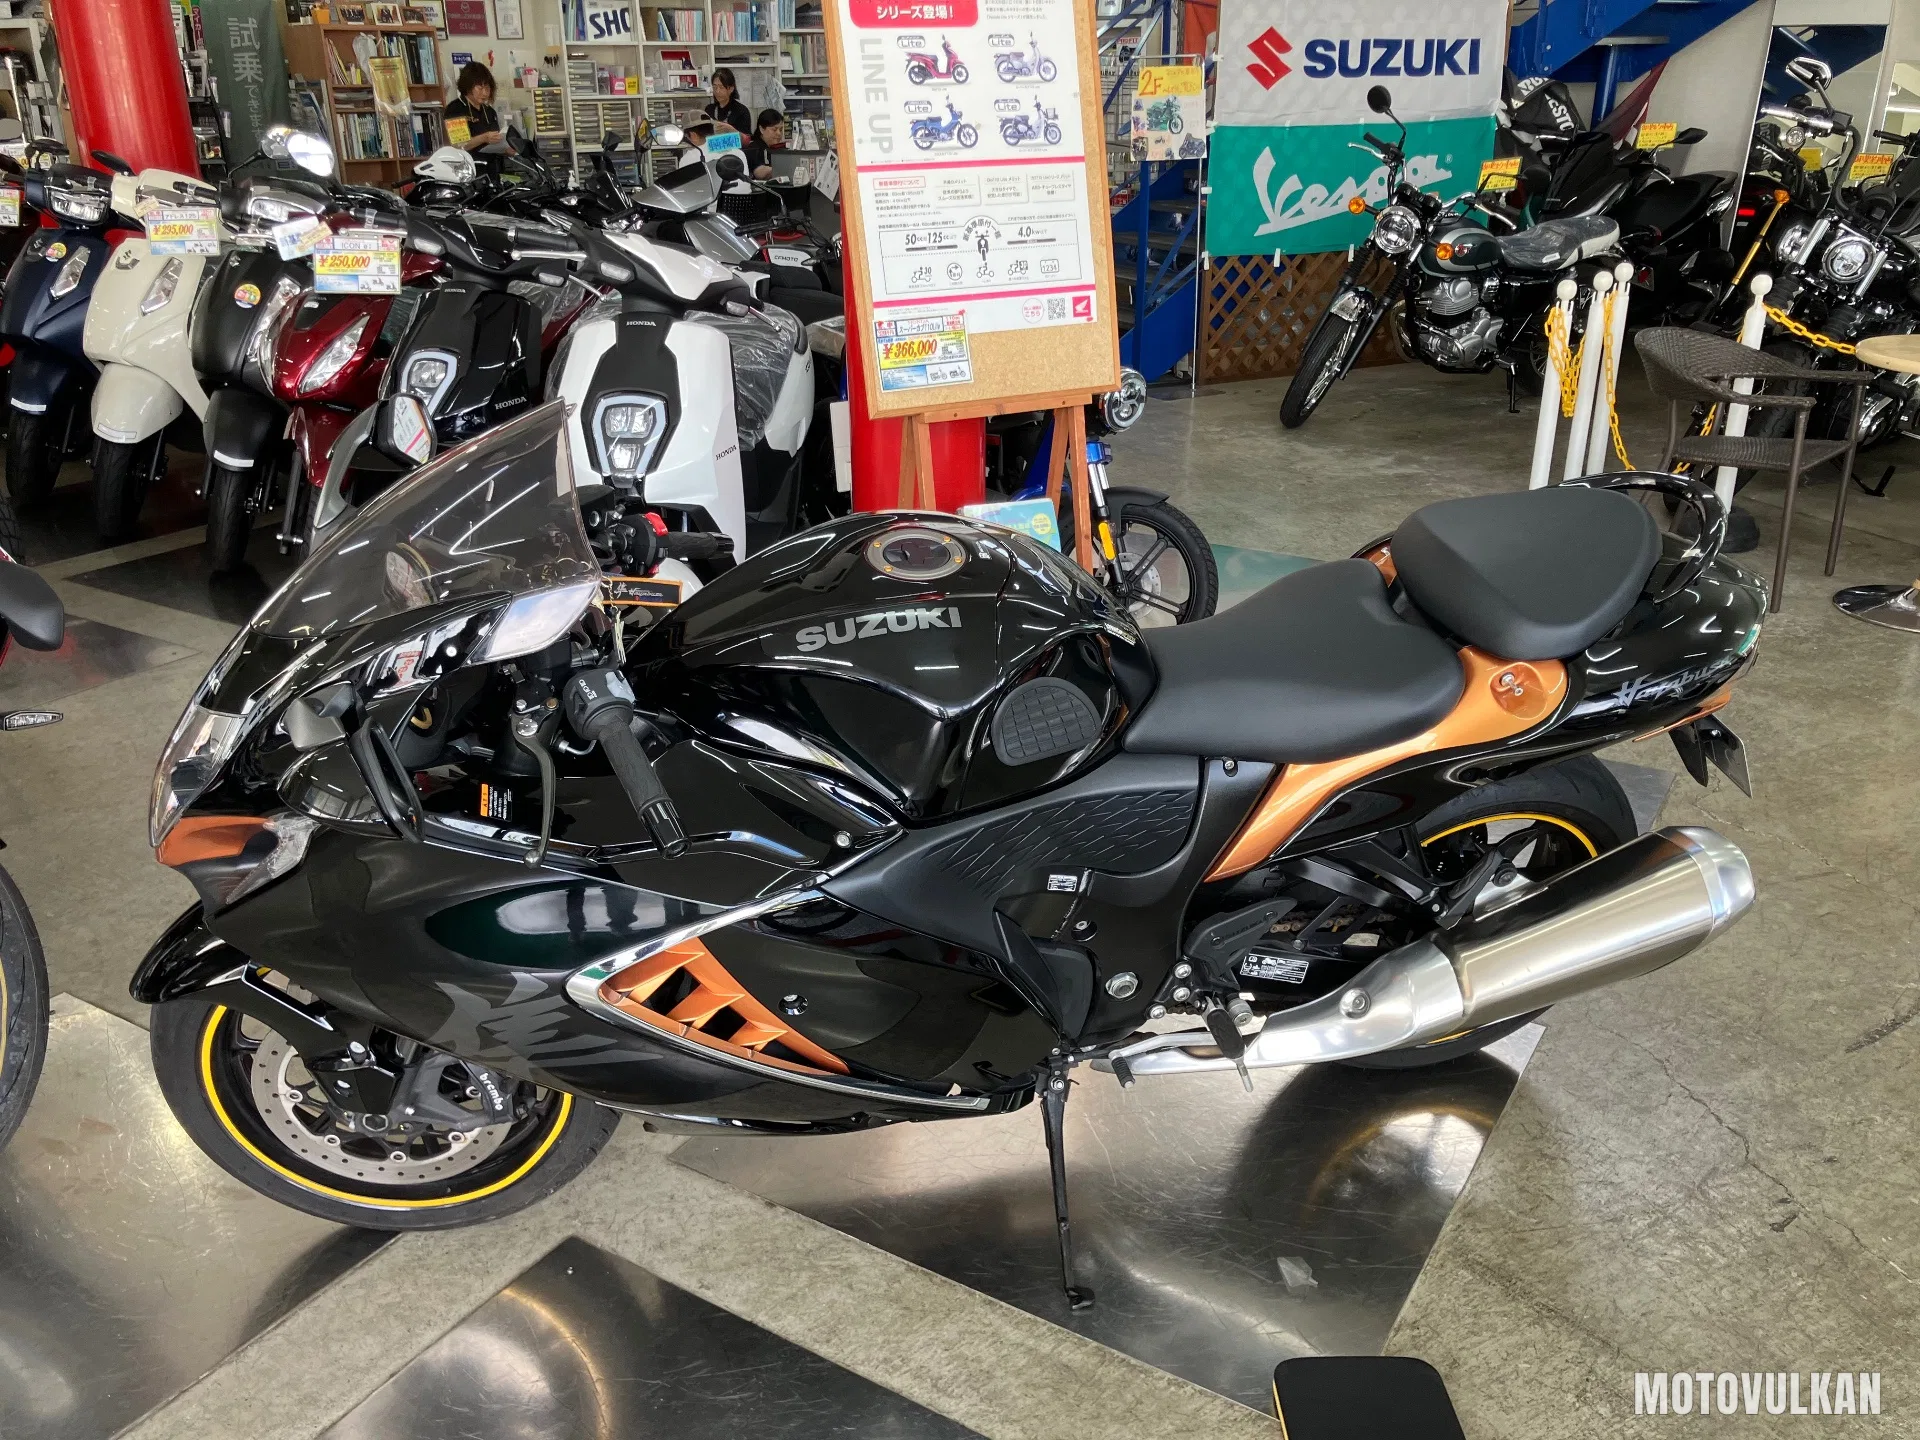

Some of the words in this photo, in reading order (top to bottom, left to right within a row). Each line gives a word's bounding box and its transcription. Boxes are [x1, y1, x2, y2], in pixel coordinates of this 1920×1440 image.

[901, 38, 923, 47] Lite
[991, 37, 1012, 46] Lite
[1303, 38, 1481, 78] SUZUKI
[860, 38, 889, 103] LINE
[907, 104, 930, 113] Lite
[997, 103, 1018, 111] Lite
[868, 113, 894, 153] UP
[1253, 146, 1453, 237] Vespa
[152, 224, 194, 236] ¥295,000
[318, 255, 371, 268] ¥250,000
[1025, 310, 1041, 318] こちら
[883, 338, 938, 360] ¥366,000
[494, 396, 527, 410] HONDA
[715, 444, 737, 461] HONDA
[795, 607, 962, 652] SUZUKI
[479, 1073, 504, 1111] brembo
